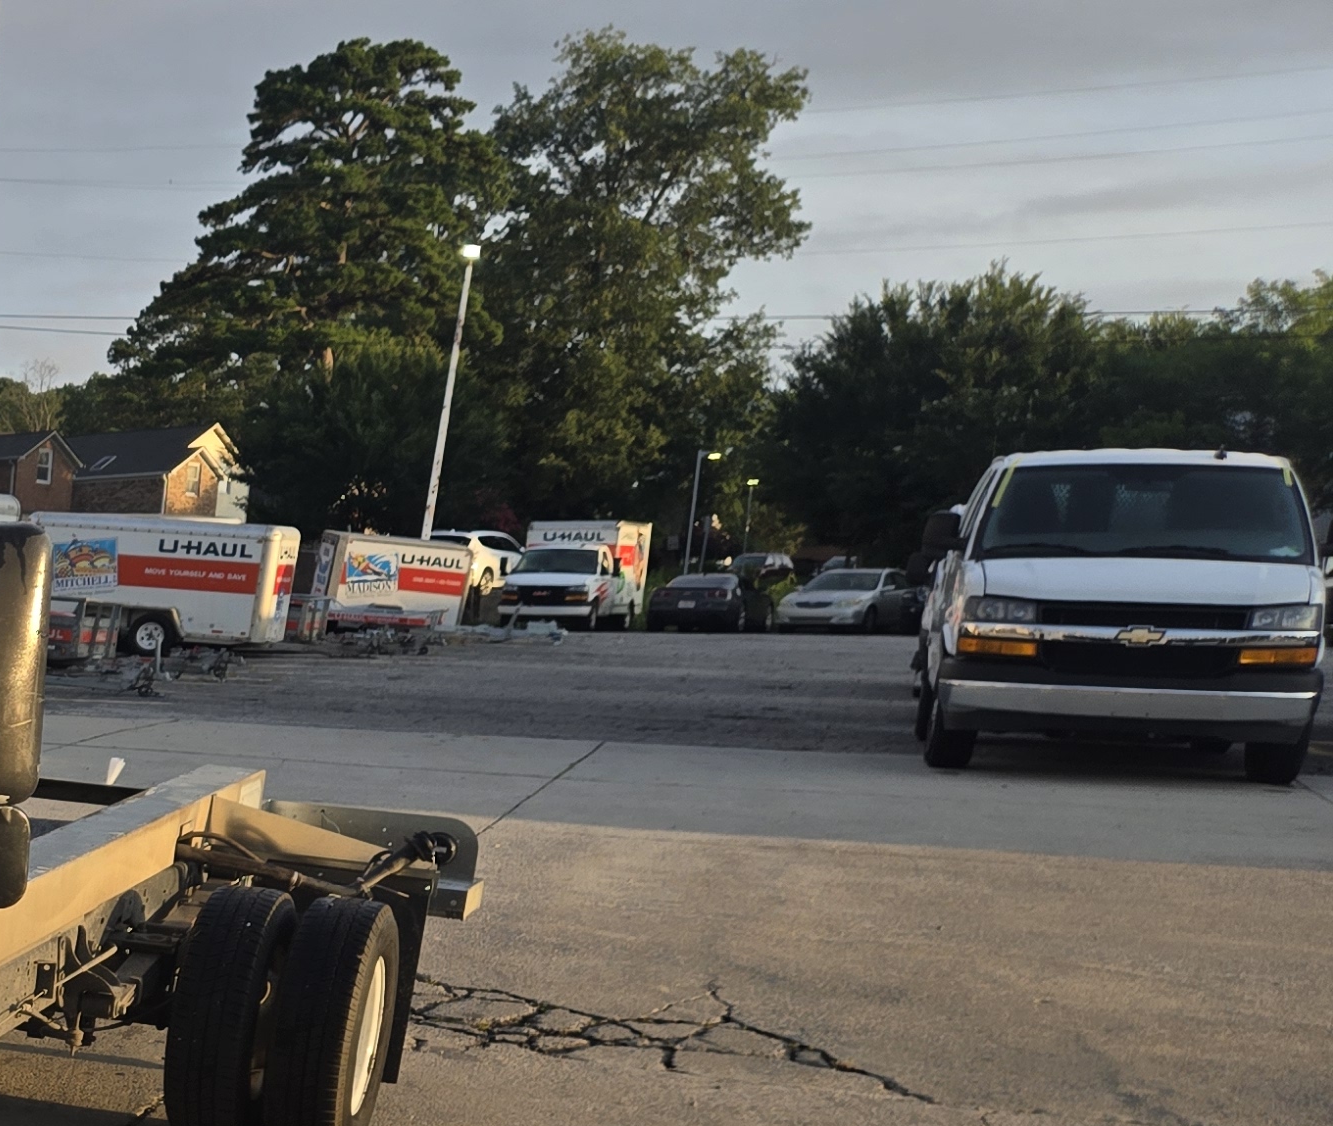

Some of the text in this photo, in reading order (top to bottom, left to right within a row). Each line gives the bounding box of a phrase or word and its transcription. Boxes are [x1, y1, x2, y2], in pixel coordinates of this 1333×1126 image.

[158, 538, 253, 559] U-HAUL
[401, 553, 464, 570] U-HAUL
[144, 567, 167, 576] MOVE
[169, 569, 207, 578] YOURSELF
[208, 571, 225, 580] AND
